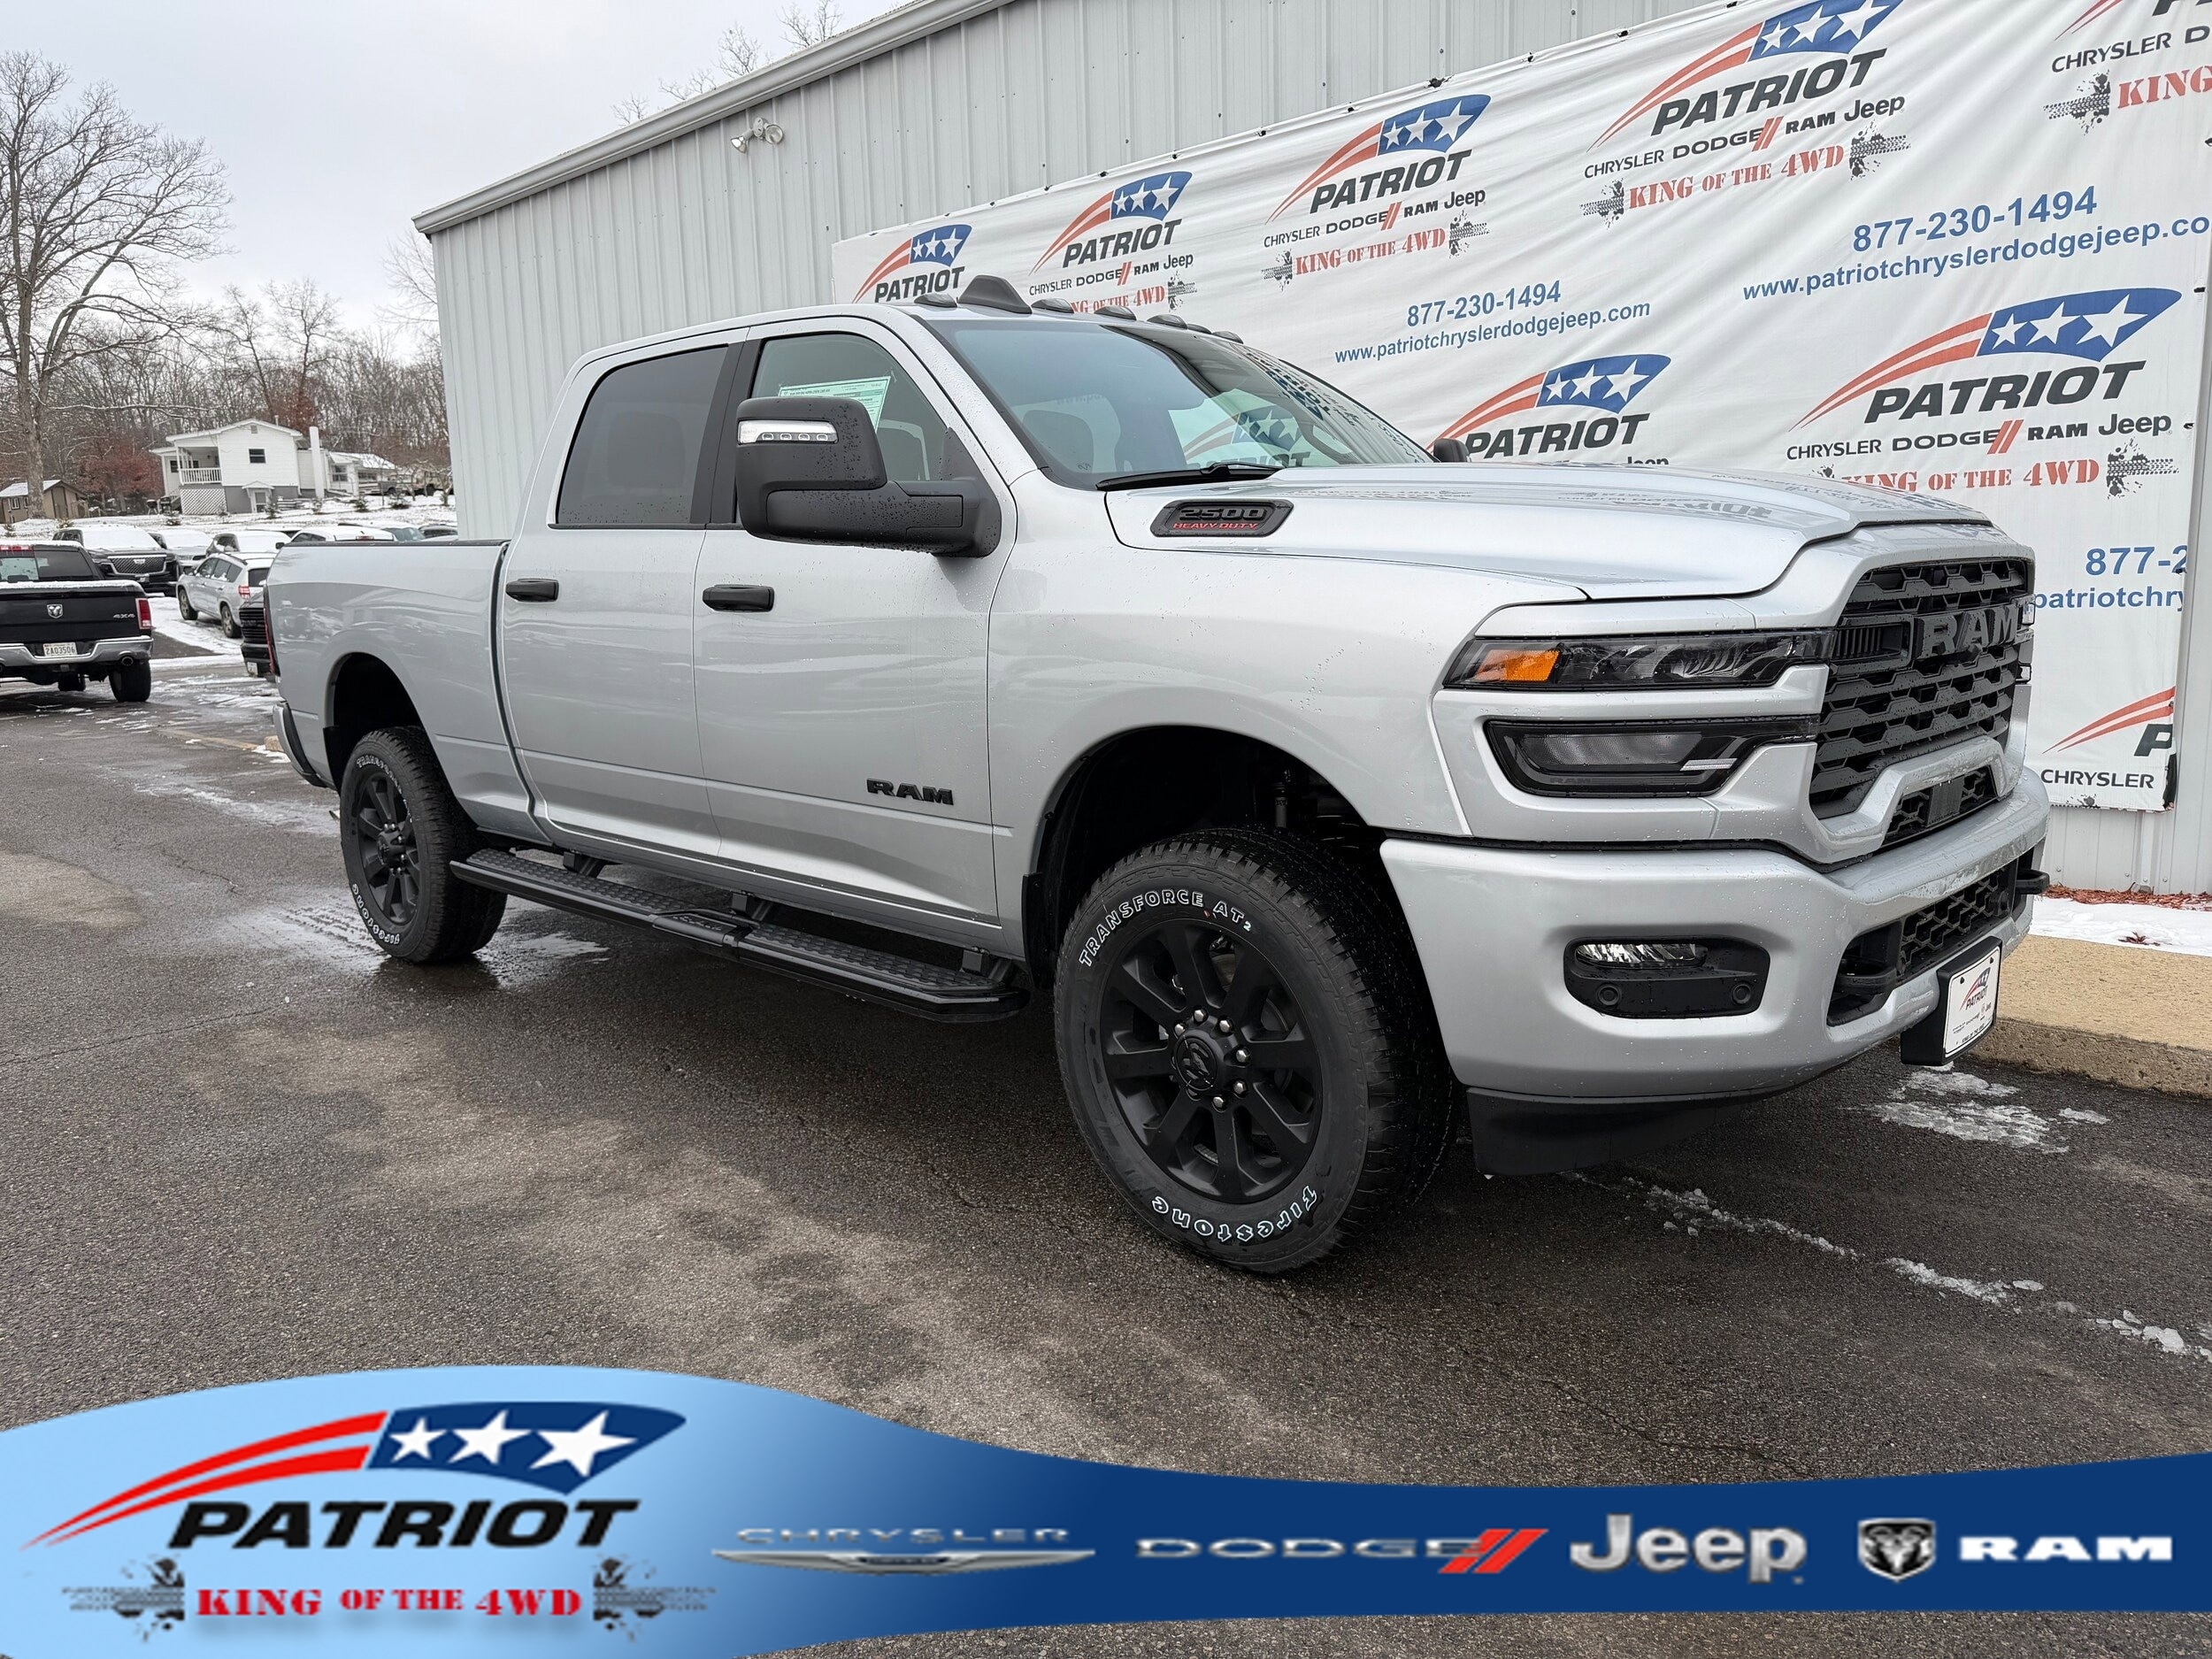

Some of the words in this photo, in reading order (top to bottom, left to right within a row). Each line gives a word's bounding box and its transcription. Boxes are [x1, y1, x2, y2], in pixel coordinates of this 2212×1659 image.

[2052, 32, 2171, 73] CHRYSLER
[1651, 48, 1887, 136] PATRIOT
[2118, 65, 2212, 108] KING
[1585, 149, 1664, 179] CHRYSLER
[1672, 127, 1763, 160] DODGE
[1786, 111, 1836, 134] RAM
[1844, 96, 1905, 123] Jeep
[1310, 150, 1471, 214] PATRIOT
[1629, 176, 1694, 210] KING
[1701, 172, 1726, 192] OF
[1731, 163, 1771, 188] THE
[1781, 144, 1845, 177] 4WD
[1263, 226, 1320, 248] CHRYSLER
[1325, 211, 1390, 234] DODGE
[1404, 201, 1438, 218] RAM
[1444, 188, 1486, 210] Jeep
[1853, 186, 2098, 252] 877-230-1494
[1062, 219, 1182, 268] PATRIOT
[1295, 249, 1341, 276] KING
[1347, 247, 1364, 263] OF
[1367, 241, 1395, 260] THE
[1402, 227, 1446, 255] 4WD
[874, 265, 965, 303] PATRIOT
[1029, 278, 1072, 296] CHRYSLER
[1076, 268, 1122, 288] DODGE
[1133, 262, 1160, 277] RAM
[1164, 254, 1194, 271] Jeep
[1108, 295, 1129, 307] THE
[1133, 286, 1165, 307] 4WD
[1407, 280, 1562, 327] 877-230-1494
[1335, 303, 1651, 364] www.patriotchryslerdodgejeep.com
[1863, 360, 2147, 424] PATRIOT
[1466, 413, 1650, 459] PATRIOT
[1786, 439, 1882, 460] CHRYSLER
[1893, 429, 2001, 451] DODGE
[2027, 423, 2088, 441] RAM
[2099, 414, 2171, 437] Jeep
[1928, 472, 1957, 490] OF
[1963, 468, 2012, 488] THE
[2023, 458, 2100, 488] 4WD
[1179, 508, 1267, 520] 2500
[1916, 604, 2017, 659] RAM
[866, 779, 954, 805] RAM
[2041, 769, 2154, 788] CHRYSLER
[1079, 889, 1204, 968] TRANSFORCE
